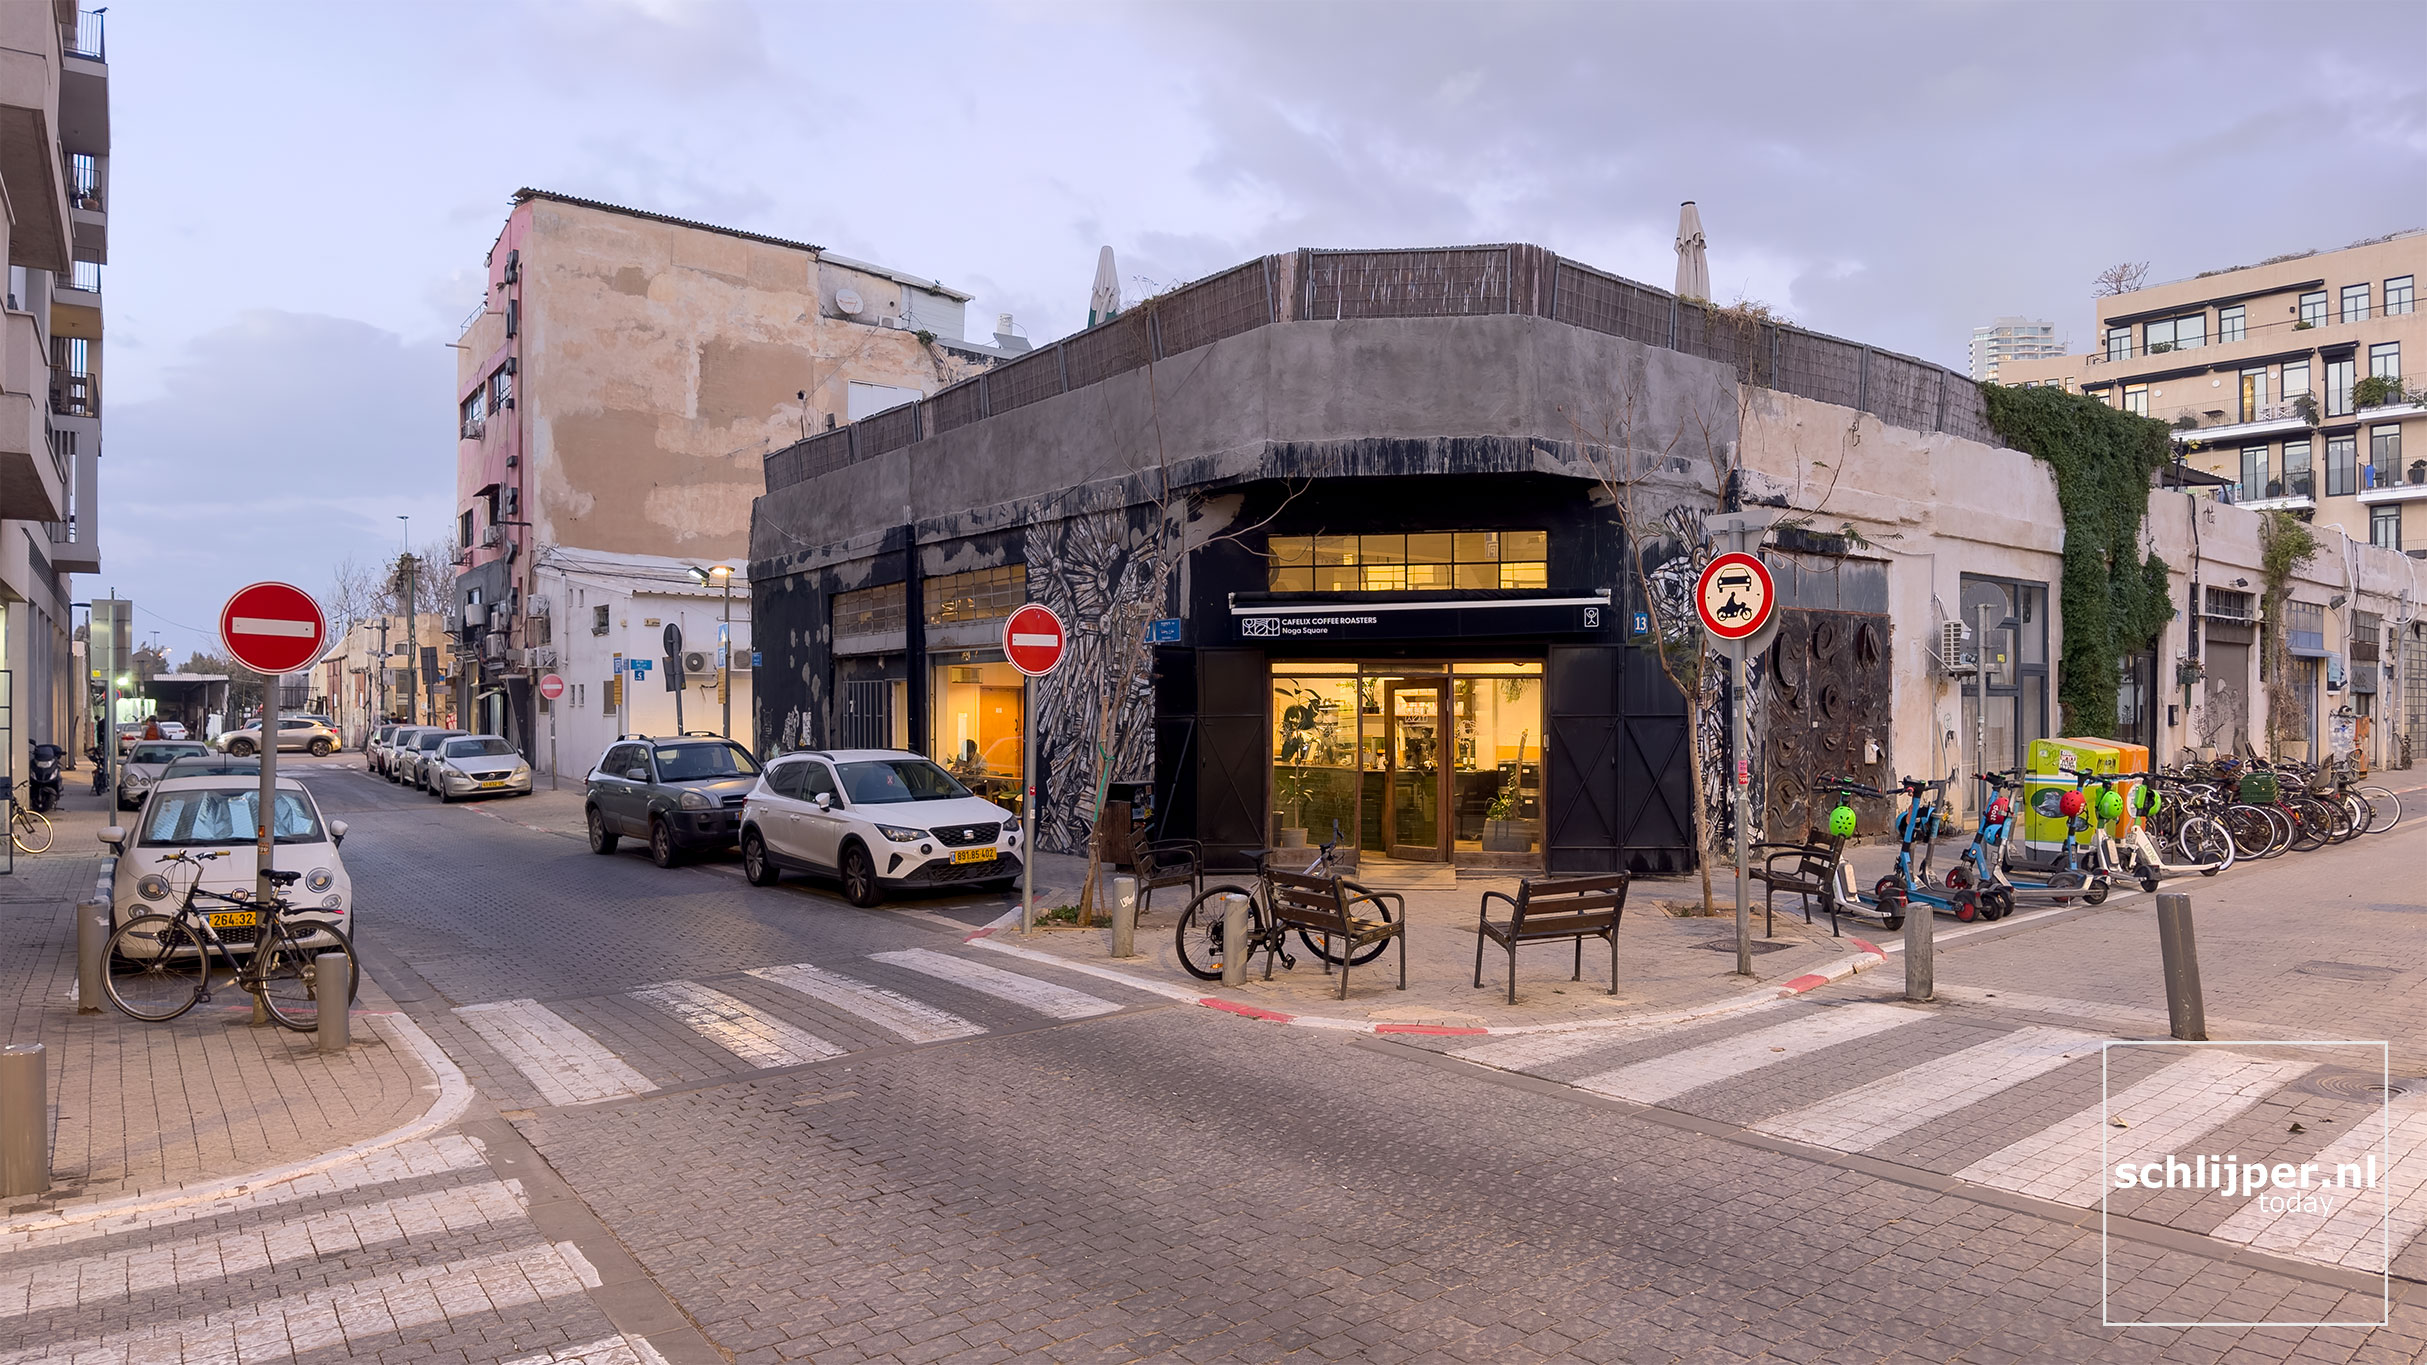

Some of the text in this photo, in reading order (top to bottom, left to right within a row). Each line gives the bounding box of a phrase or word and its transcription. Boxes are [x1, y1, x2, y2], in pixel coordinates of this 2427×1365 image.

[1281, 616, 1378, 626] CAFELIX COFFEE ROASTERS
[1635, 616, 1647, 631] 13
[1281, 627, 1329, 636] Noga Square
